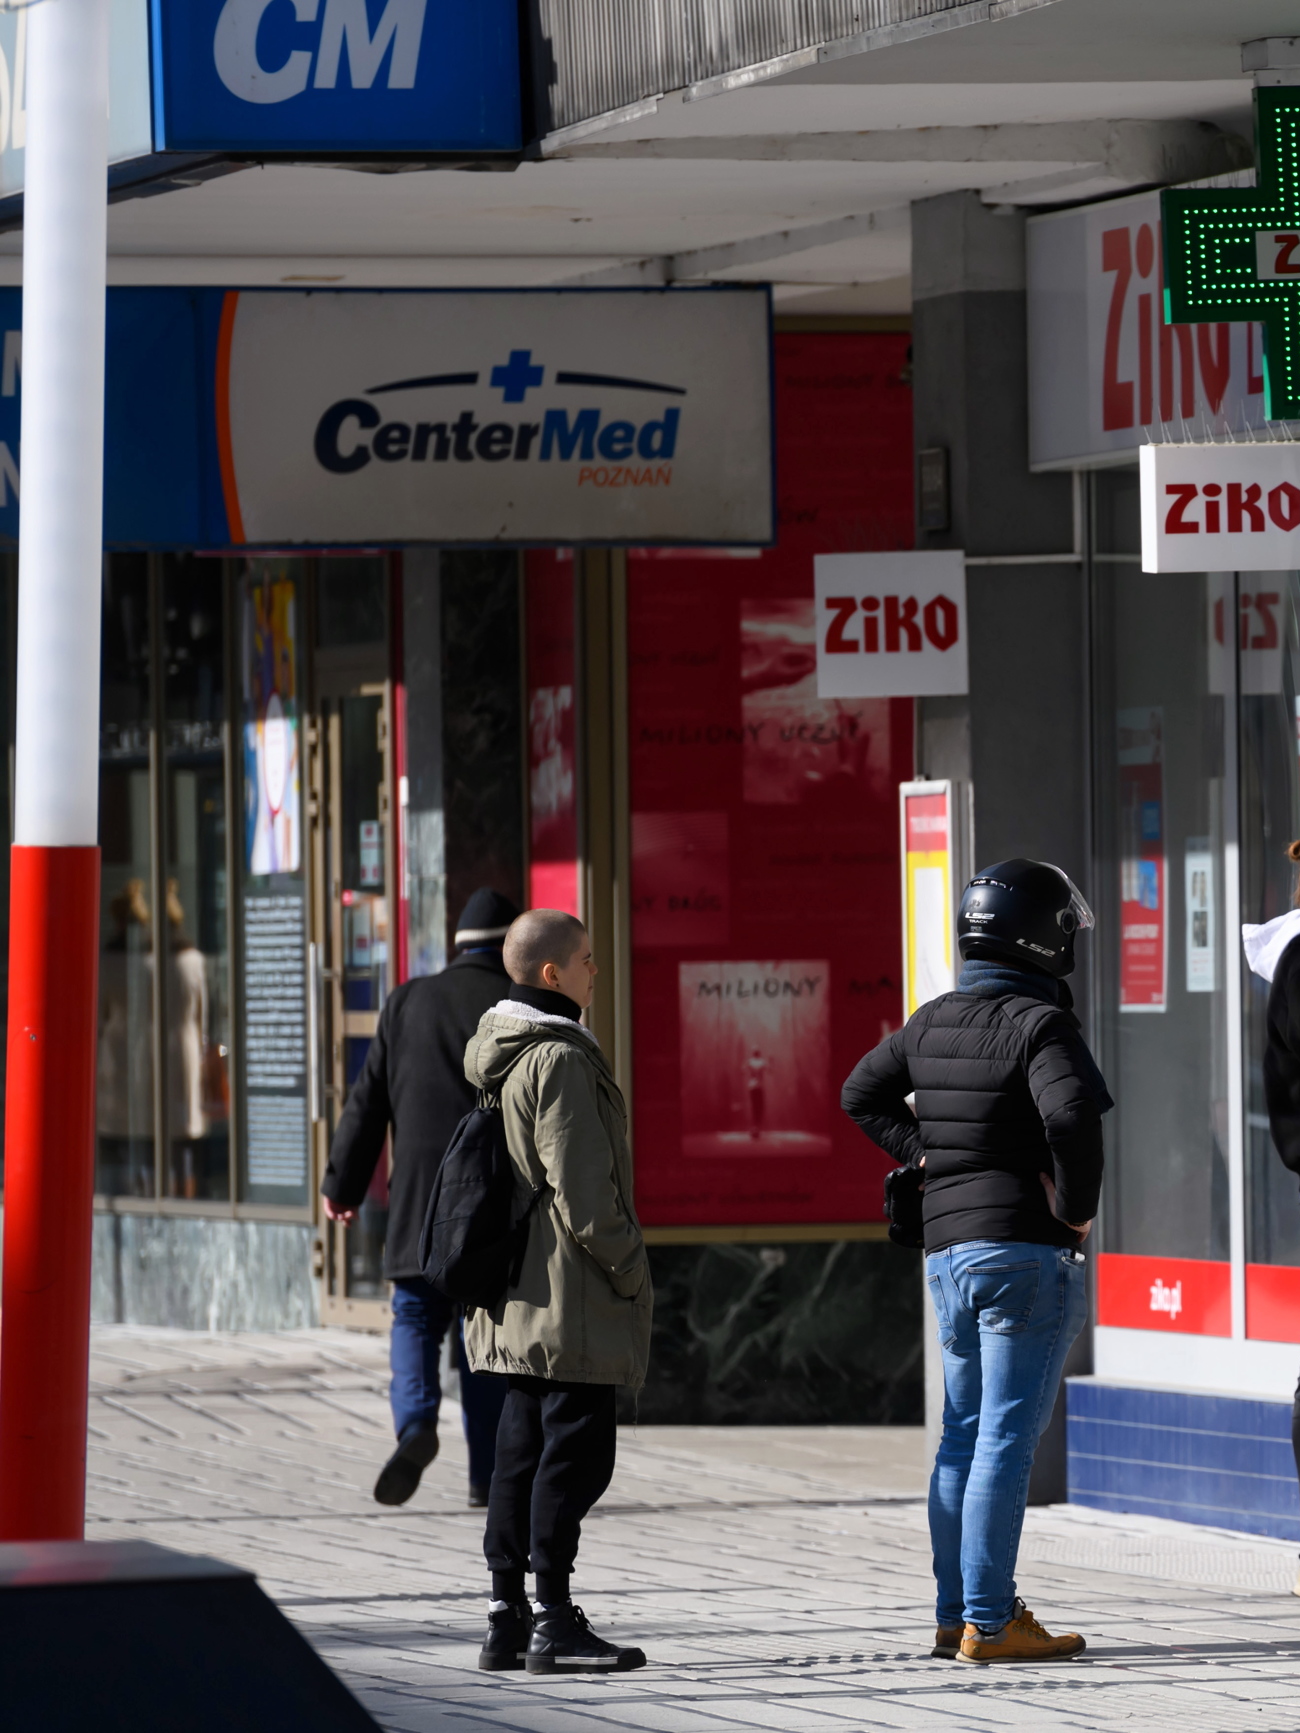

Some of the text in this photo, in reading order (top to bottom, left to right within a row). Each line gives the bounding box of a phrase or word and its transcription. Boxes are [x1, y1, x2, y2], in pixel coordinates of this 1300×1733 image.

[213, 0, 427, 104] CM
[313, 399, 681, 475] CenterMed
[578, 461, 673, 488] POZNAŃ
[964, 911, 996, 920] LS2
[1016, 938, 1056, 958] LS2
[697, 975, 823, 1000] MILIONY
